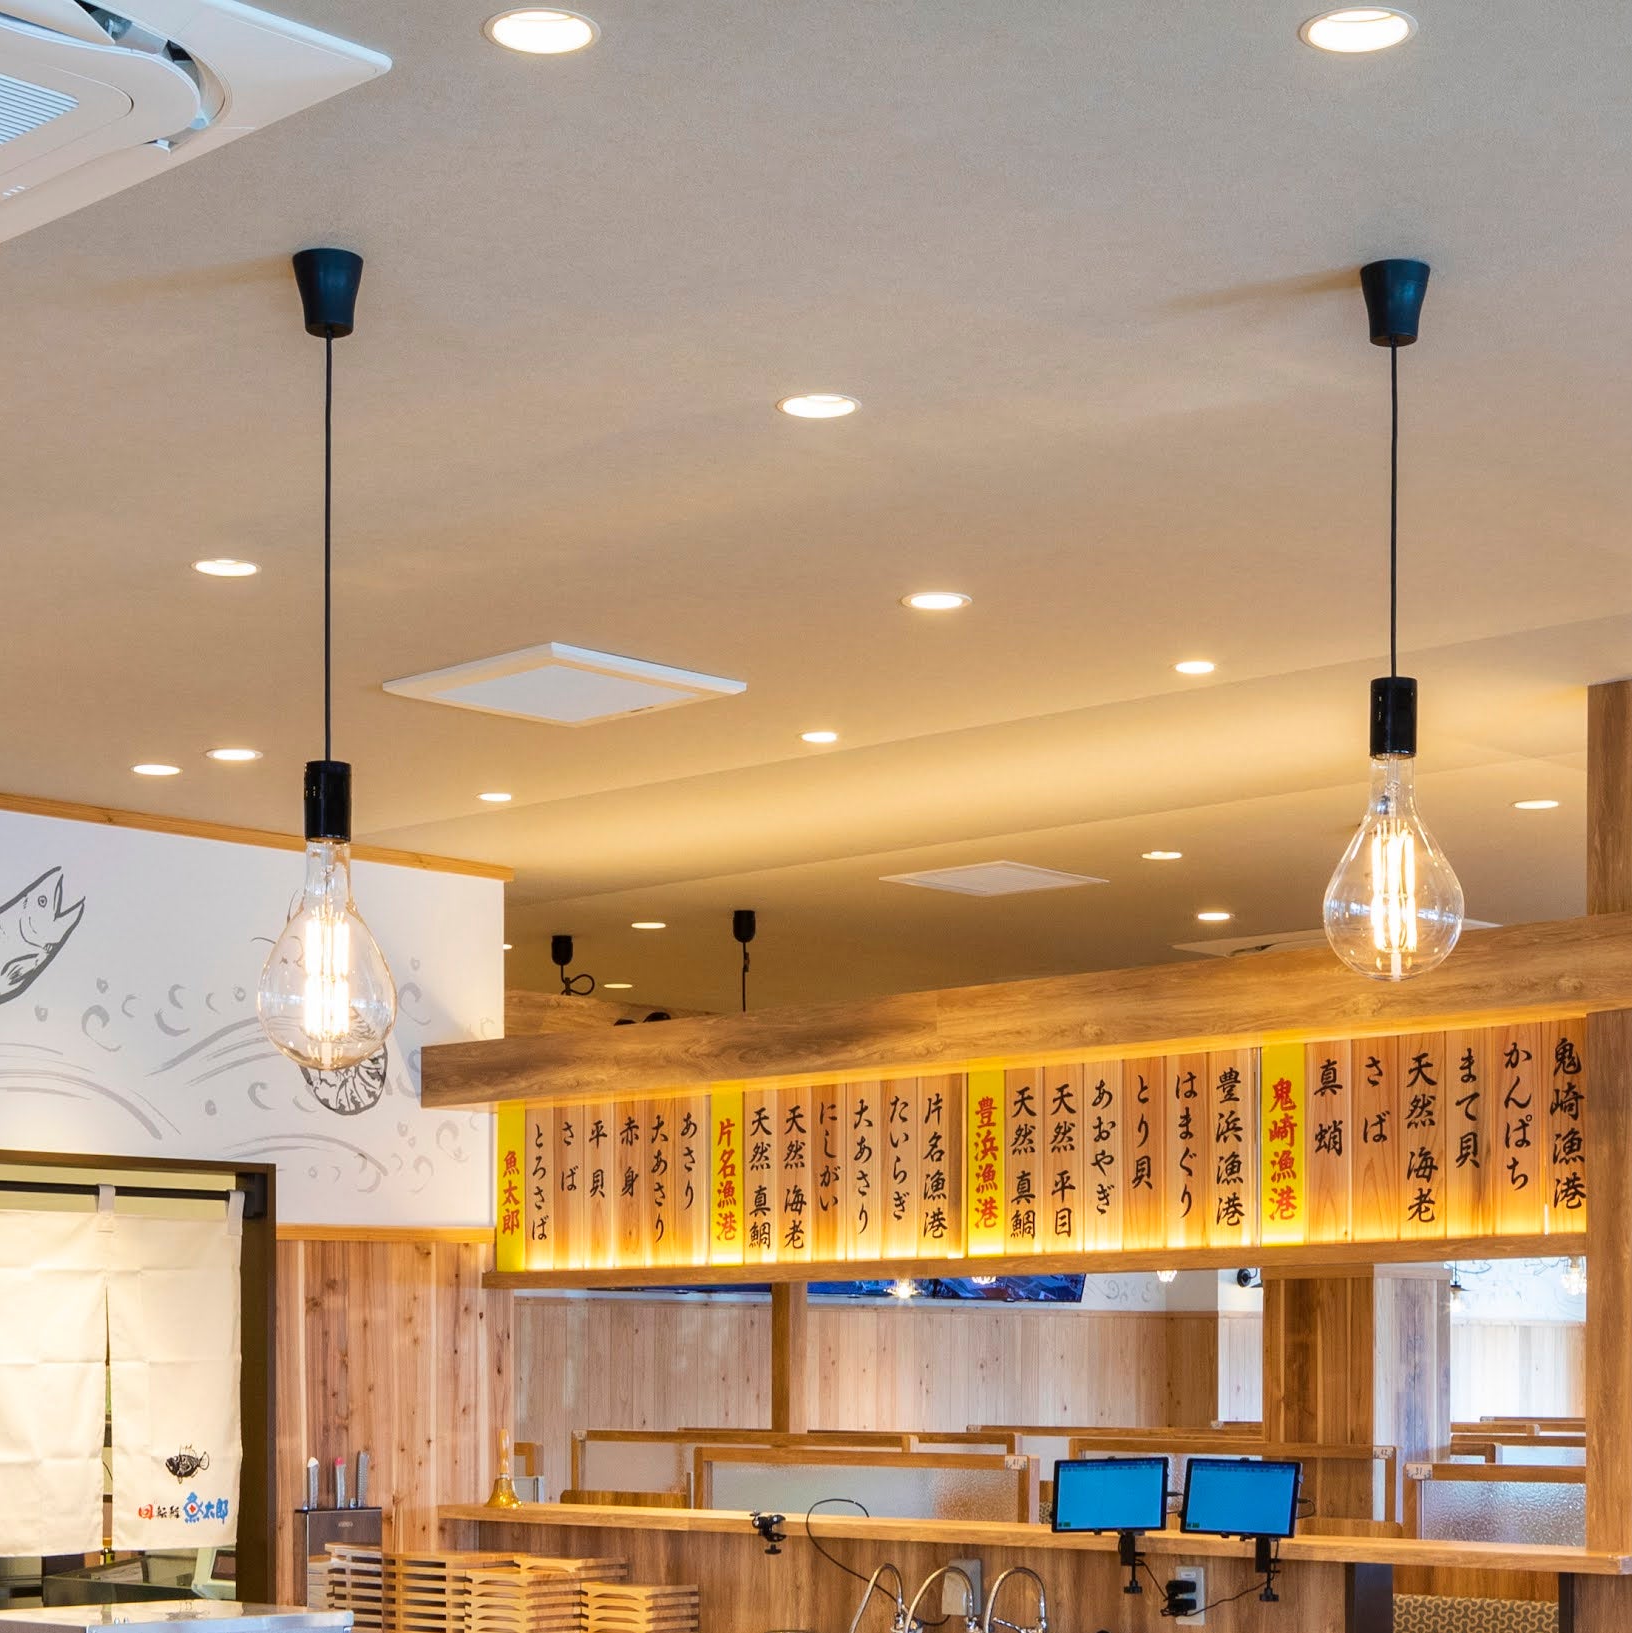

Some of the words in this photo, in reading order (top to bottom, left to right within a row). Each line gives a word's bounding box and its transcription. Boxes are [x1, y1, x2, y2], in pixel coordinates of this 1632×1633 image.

[560, 1121, 578, 1191] さば
[589, 1120, 607, 1198] 平貝
[620, 1116, 639, 1197] 赤身
[680, 1112, 697, 1210] あさり
[820, 1102, 840, 1211] にしがい
[889, 1096, 909, 1220] たいらぎ
[1090, 1079, 1116, 1215] あおやぎ
[1133, 1075, 1153, 1191] とり貝
[1176, 1072, 1198, 1218] はまぐり
[1216, 1067, 1245, 1226] 豊浜漁港
[1269, 1077, 1297, 1221] 鬼崎漁港
[1313, 1058, 1343, 1157] 真蛸
[1363, 1056, 1390, 1143] さば
[1455, 1048, 1480, 1168] まて貝
[1504, 1042, 1532, 1191] かんぱち
[1550, 1038, 1586, 1209] 鬼崎漁港
[502, 1151, 519, 1235] 魚太郎
[532, 1124, 549, 1240] とろさば
[651, 1114, 670, 1243] 大あさり
[717, 1118, 737, 1241] 片名漁港
[853, 1099, 873, 1234] 大あさり
[923, 1093, 948, 1239] 片名漁港
[974, 1096, 999, 1229] 豊浜漁港
